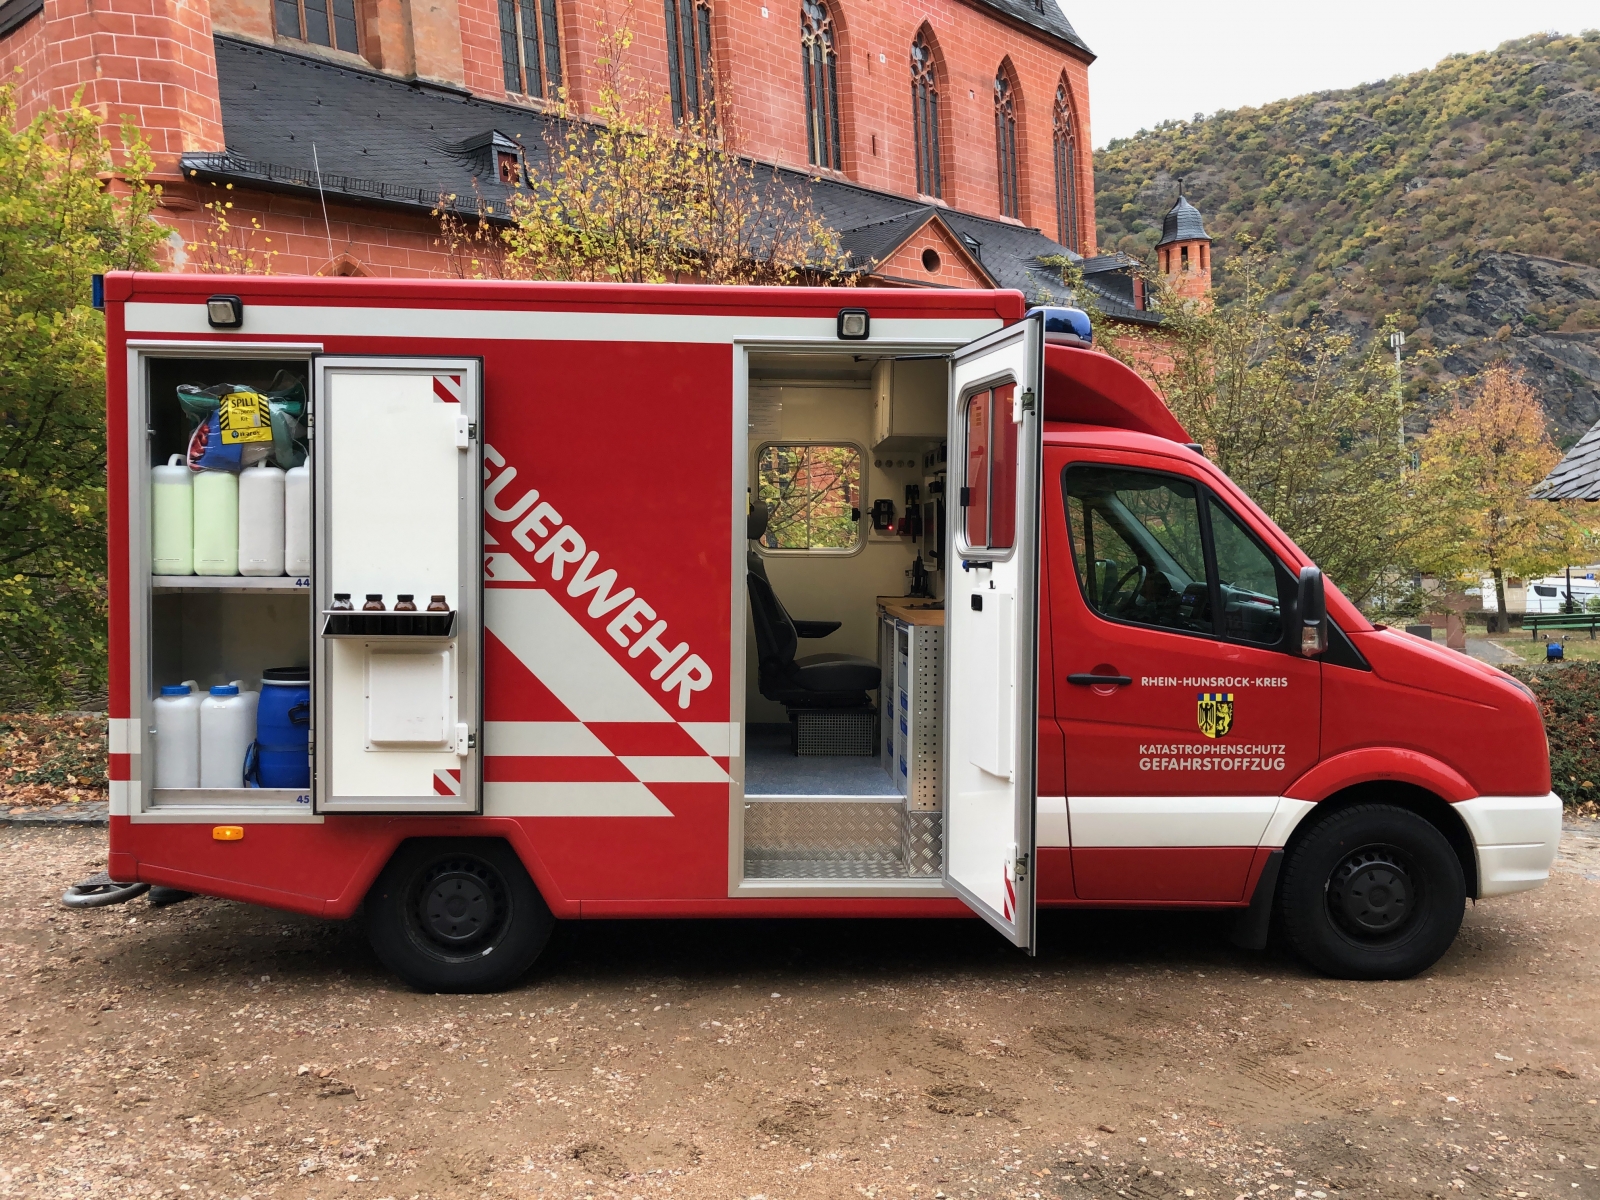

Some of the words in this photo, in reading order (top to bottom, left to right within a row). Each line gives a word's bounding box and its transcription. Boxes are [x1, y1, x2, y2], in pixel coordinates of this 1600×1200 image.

[231, 397, 256, 408] SPILL
[295, 578, 310, 587] 44
[1141, 676, 1288, 687] RHEIN-HUNSRÜCK-KREIS
[1139, 744, 1286, 755] KATASTROPHENSCHUTZ
[1139, 757, 1286, 771] GEFAHRSTOFFZUG
[296, 794, 310, 804] 45
